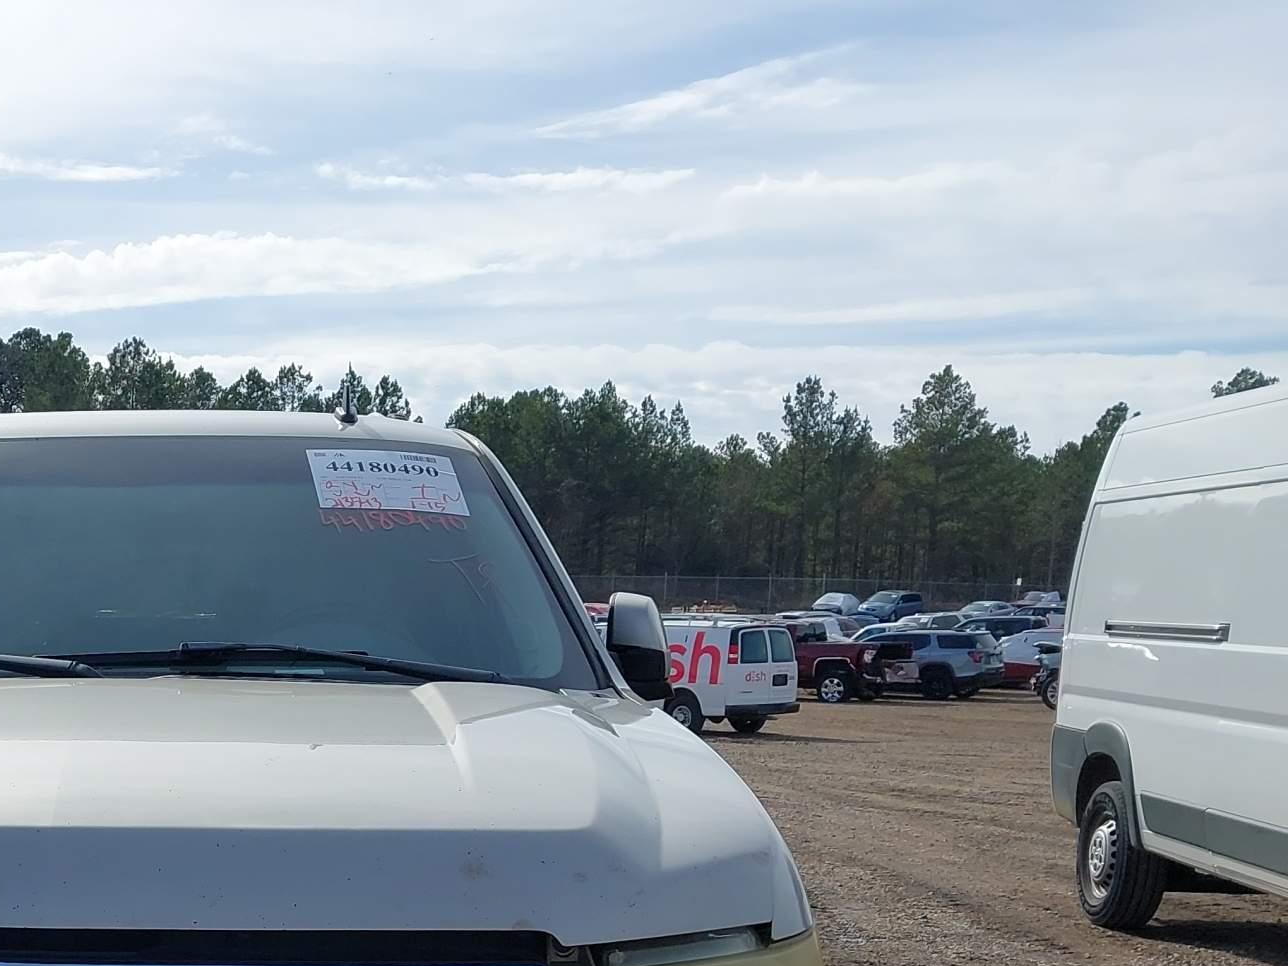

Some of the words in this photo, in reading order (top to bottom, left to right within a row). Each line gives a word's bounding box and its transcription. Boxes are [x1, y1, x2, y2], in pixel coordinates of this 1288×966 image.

[326, 460, 439, 478] 44180490
[668, 631, 721, 685] sh
[745, 671, 767, 682] dish
